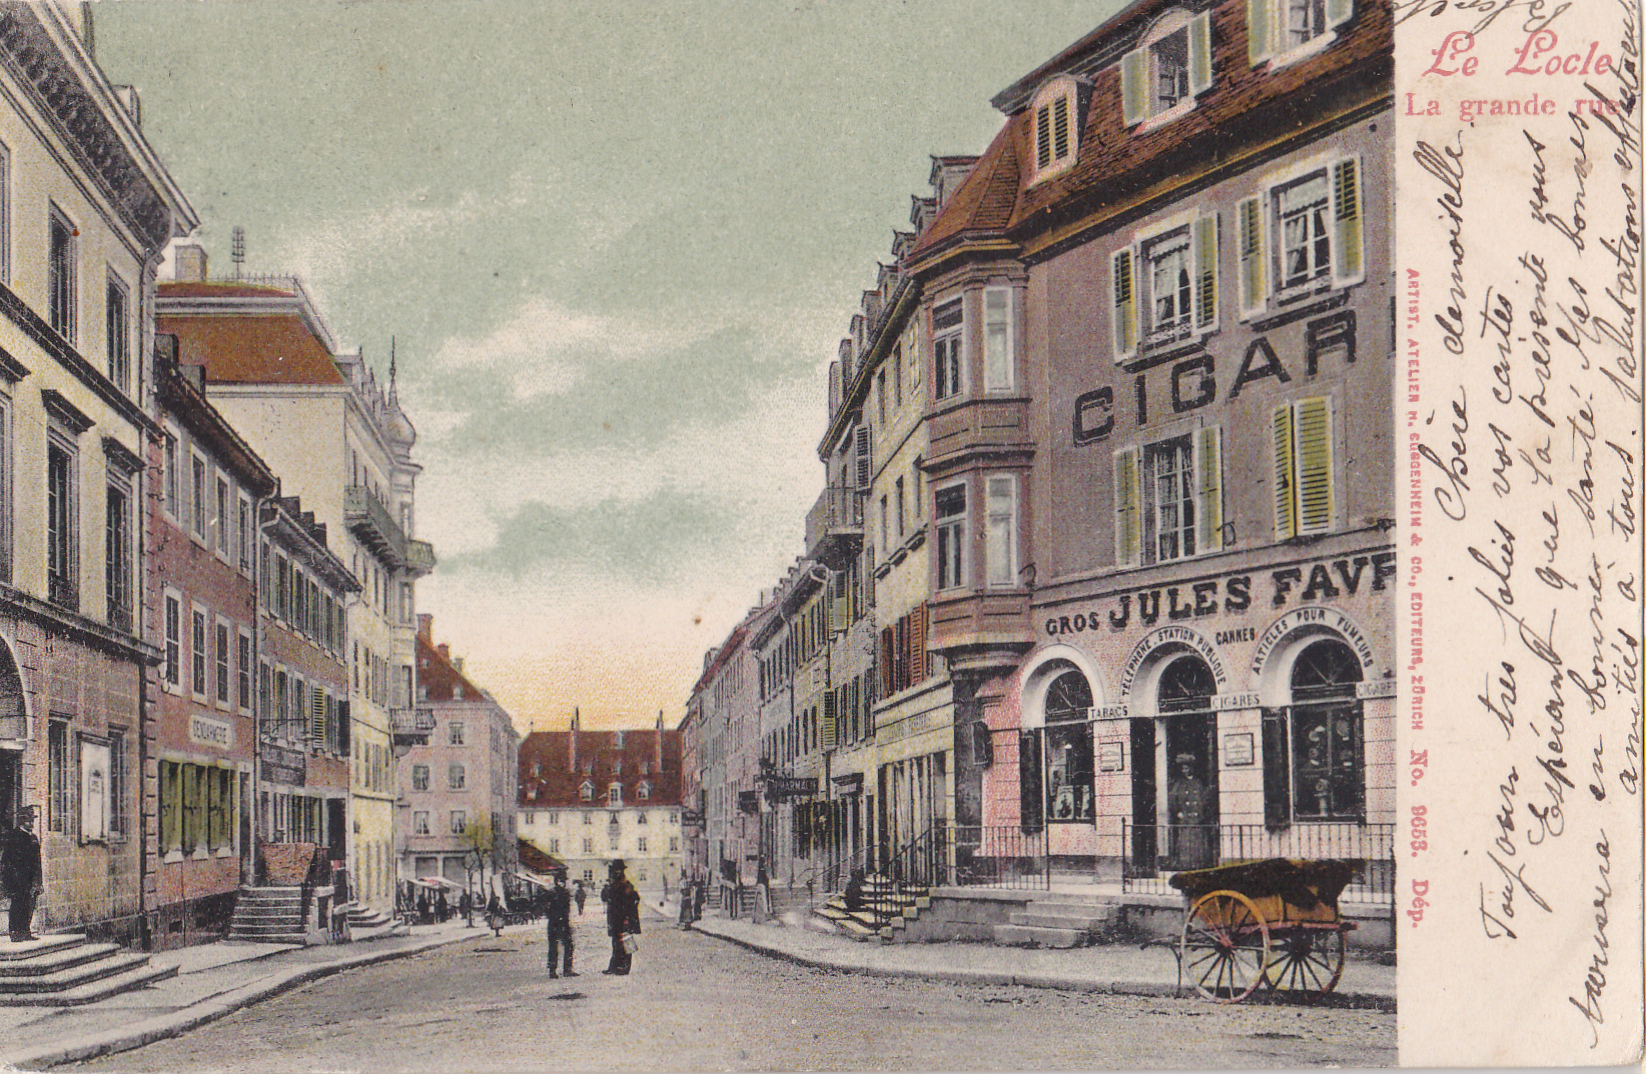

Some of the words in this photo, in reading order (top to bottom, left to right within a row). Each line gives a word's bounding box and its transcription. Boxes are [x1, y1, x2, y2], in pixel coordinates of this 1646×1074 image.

[1073, 295, 1396, 448] CIGAR
[1517, 435, 1554, 485] la
[1044, 611, 1100, 636] GROS
[1108, 576, 1252, 631] JULES
[1157, 628, 1196, 642] STATION
[1196, 636, 1227, 685] PUBLIQUE
[1215, 627, 1256, 645] CANNES
[1252, 619, 1289, 676] ARTICLES
[1296, 609, 1326, 622] POUR
[1336, 616, 1375, 669] FUMEURS
[1090, 705, 1129, 719] TABACS
[1211, 693, 1260, 710] CIGARES
